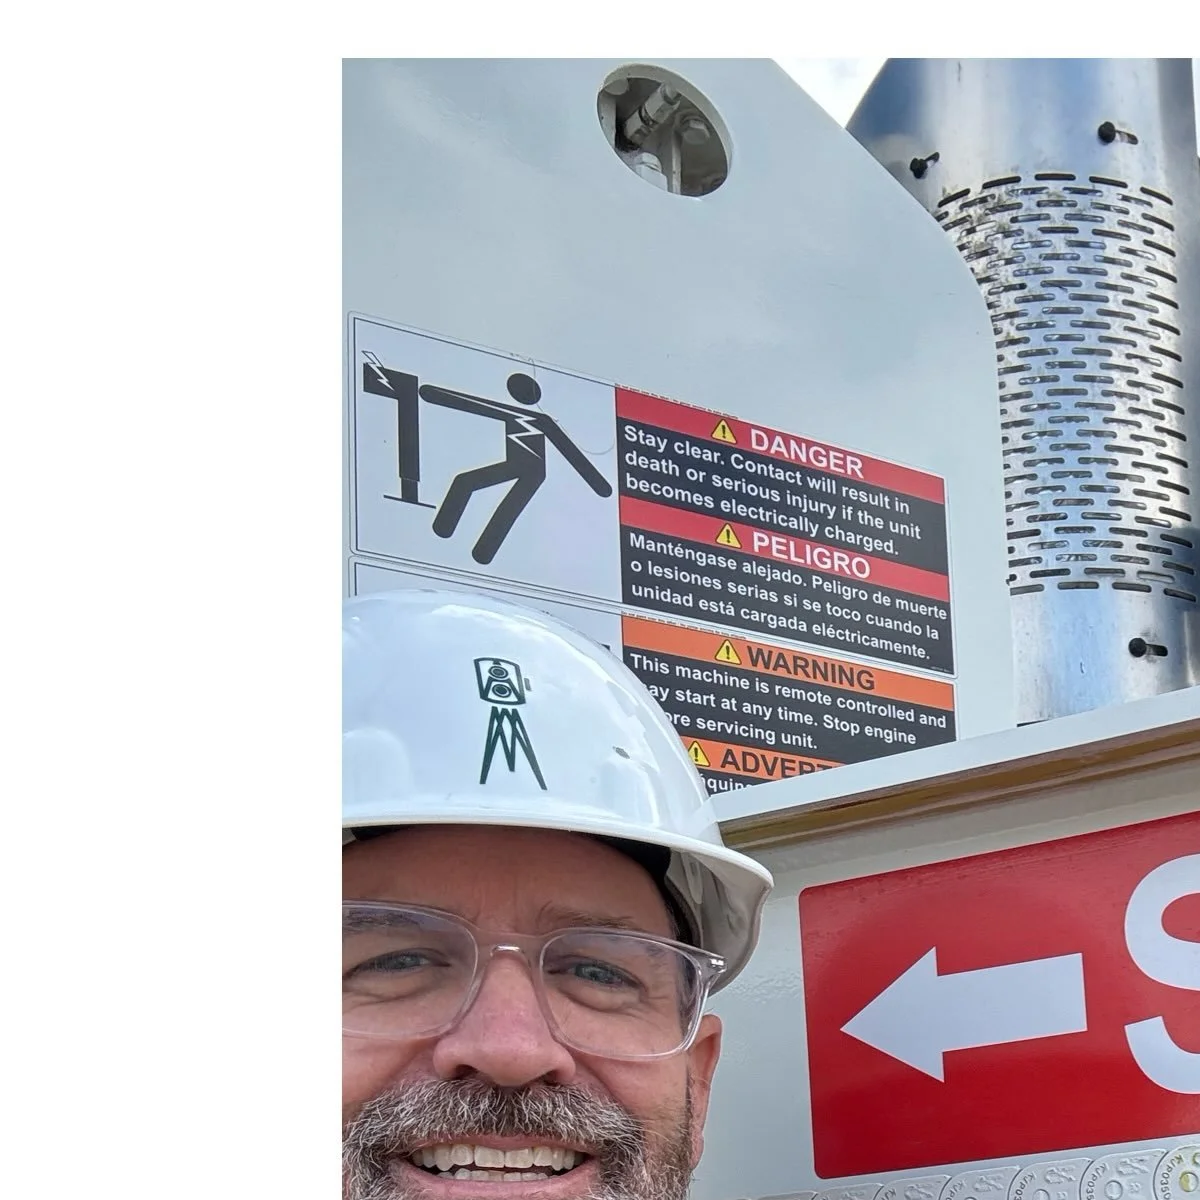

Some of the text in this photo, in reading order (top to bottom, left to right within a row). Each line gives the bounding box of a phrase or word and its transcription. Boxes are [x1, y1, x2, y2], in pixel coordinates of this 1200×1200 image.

[624, 425, 910, 515] Stay clear. Contact will result in
[751, 428, 865, 480] DANGER
[625, 451, 922, 541] death or serious injury if the unit
[626, 472, 899, 558] becomes electrically charged.
[629, 531, 948, 621] Manténgase alejado. Peligro de muerte
[753, 530, 871, 580] PELIGRO
[630, 560, 939, 641] o lesiones serias si se toco cuando la
[631, 582, 693, 608] unidad
[699, 598, 735, 617] está
[740, 607, 807, 633] cargada
[812, 620, 931, 661] eléctricamente.
[630, 653, 947, 729] This machine is remote controlled and
[747, 644, 876, 692] WARNING
[645, 683, 917, 745] ay start at any time. Stop engine
[696, 717, 776, 745] servicing
[781, 732, 818, 750] unit.
